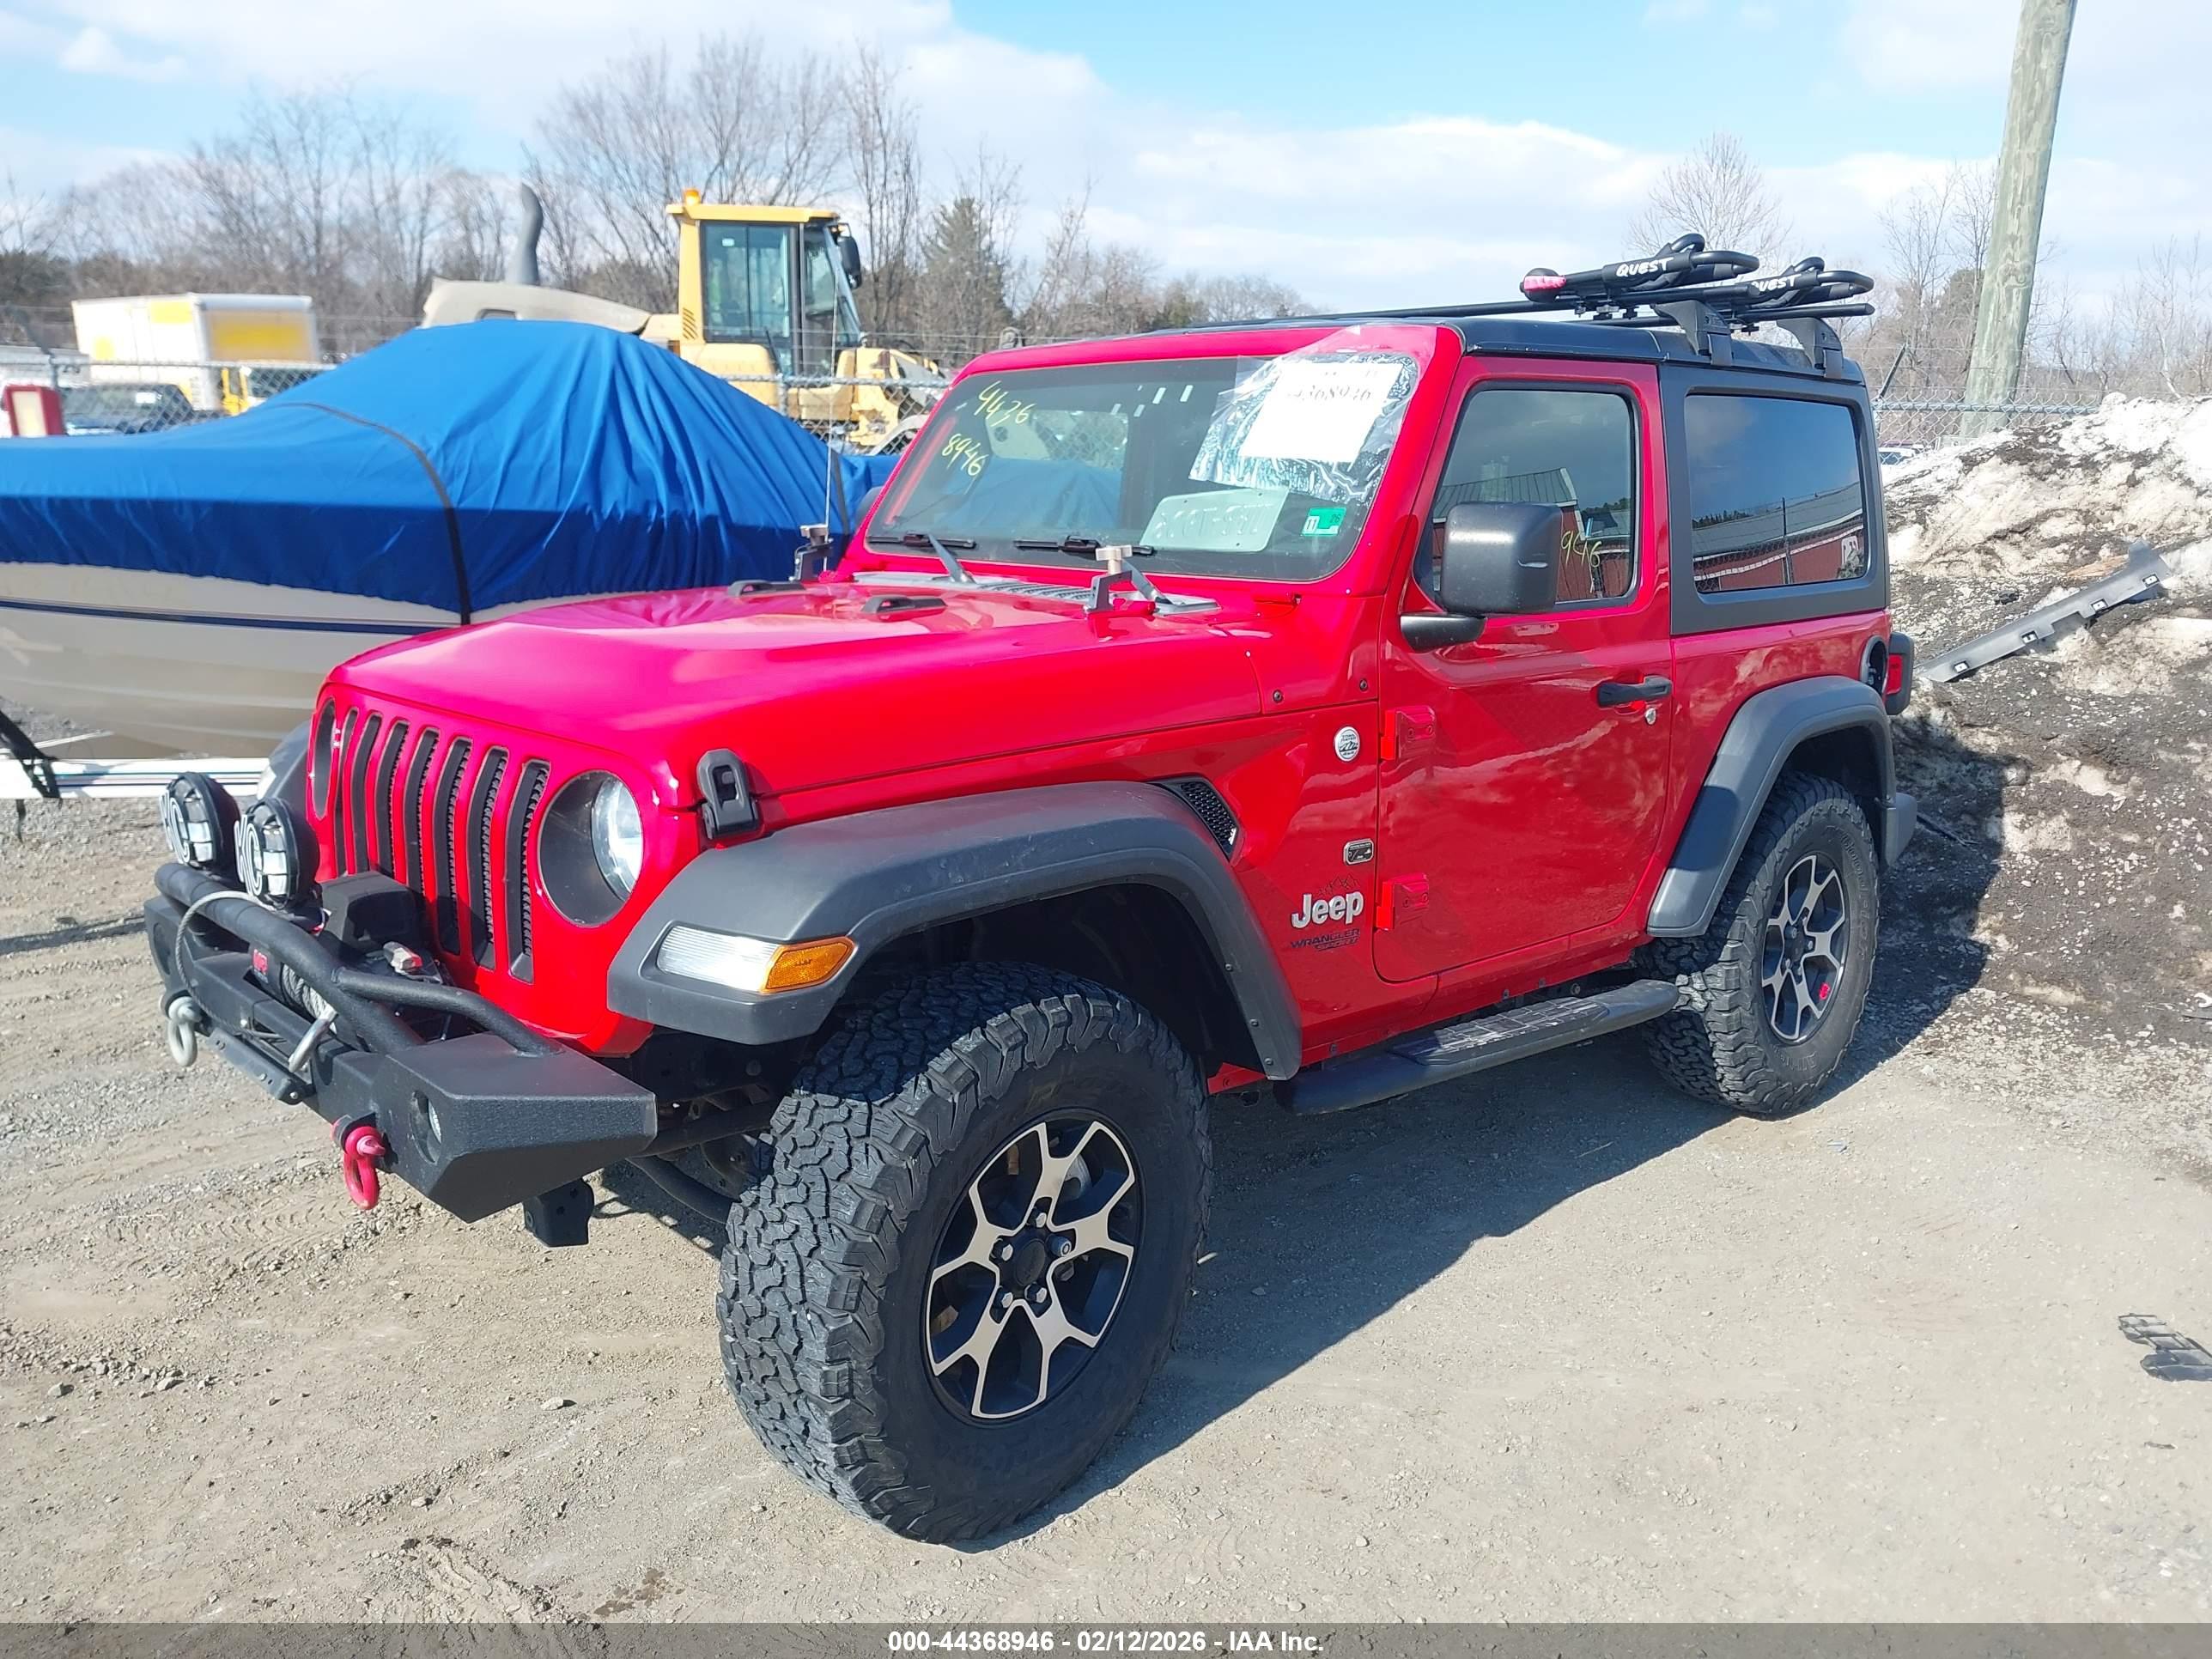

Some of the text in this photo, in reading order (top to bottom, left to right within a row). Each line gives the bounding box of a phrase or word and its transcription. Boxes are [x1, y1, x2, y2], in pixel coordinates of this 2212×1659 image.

[1616, 258, 1674, 277] QUEST
[973, 380, 1036, 428] 4436
[941, 433, 989, 477] 8946
[159, 789, 191, 865] KC
[233, 814, 263, 897] KC
[1291, 890, 1364, 929] Jeep
[1291, 928, 1360, 948] WRANGLER
